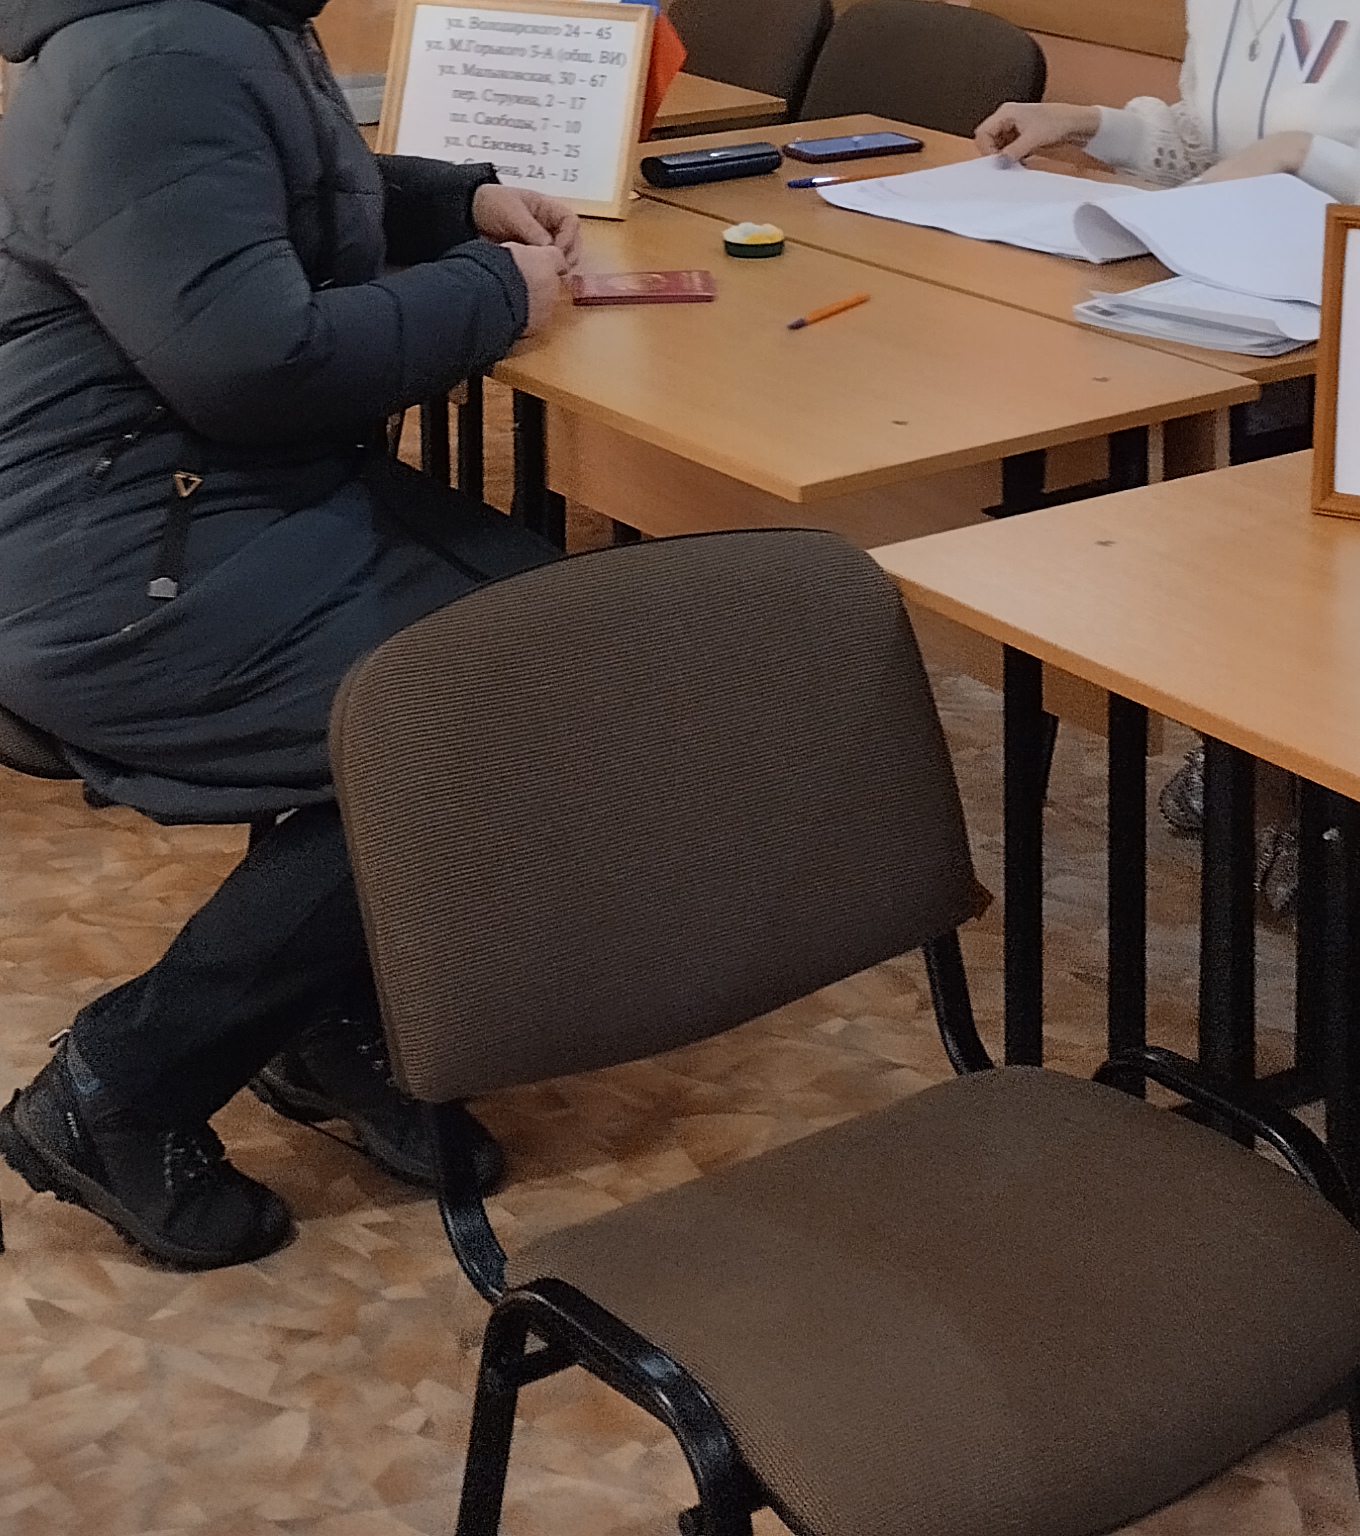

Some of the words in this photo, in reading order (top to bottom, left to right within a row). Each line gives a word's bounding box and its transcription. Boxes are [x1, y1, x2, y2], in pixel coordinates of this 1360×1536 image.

[563, 23, 581, 38] 24
[595, 26, 613, 41] 45
[589, 73, 608, 89] 67
[544, 94, 555, 108] 2
[569, 96, 587, 110] 17
[563, 144, 582, 159] 25
[561, 168, 579, 183] 15
